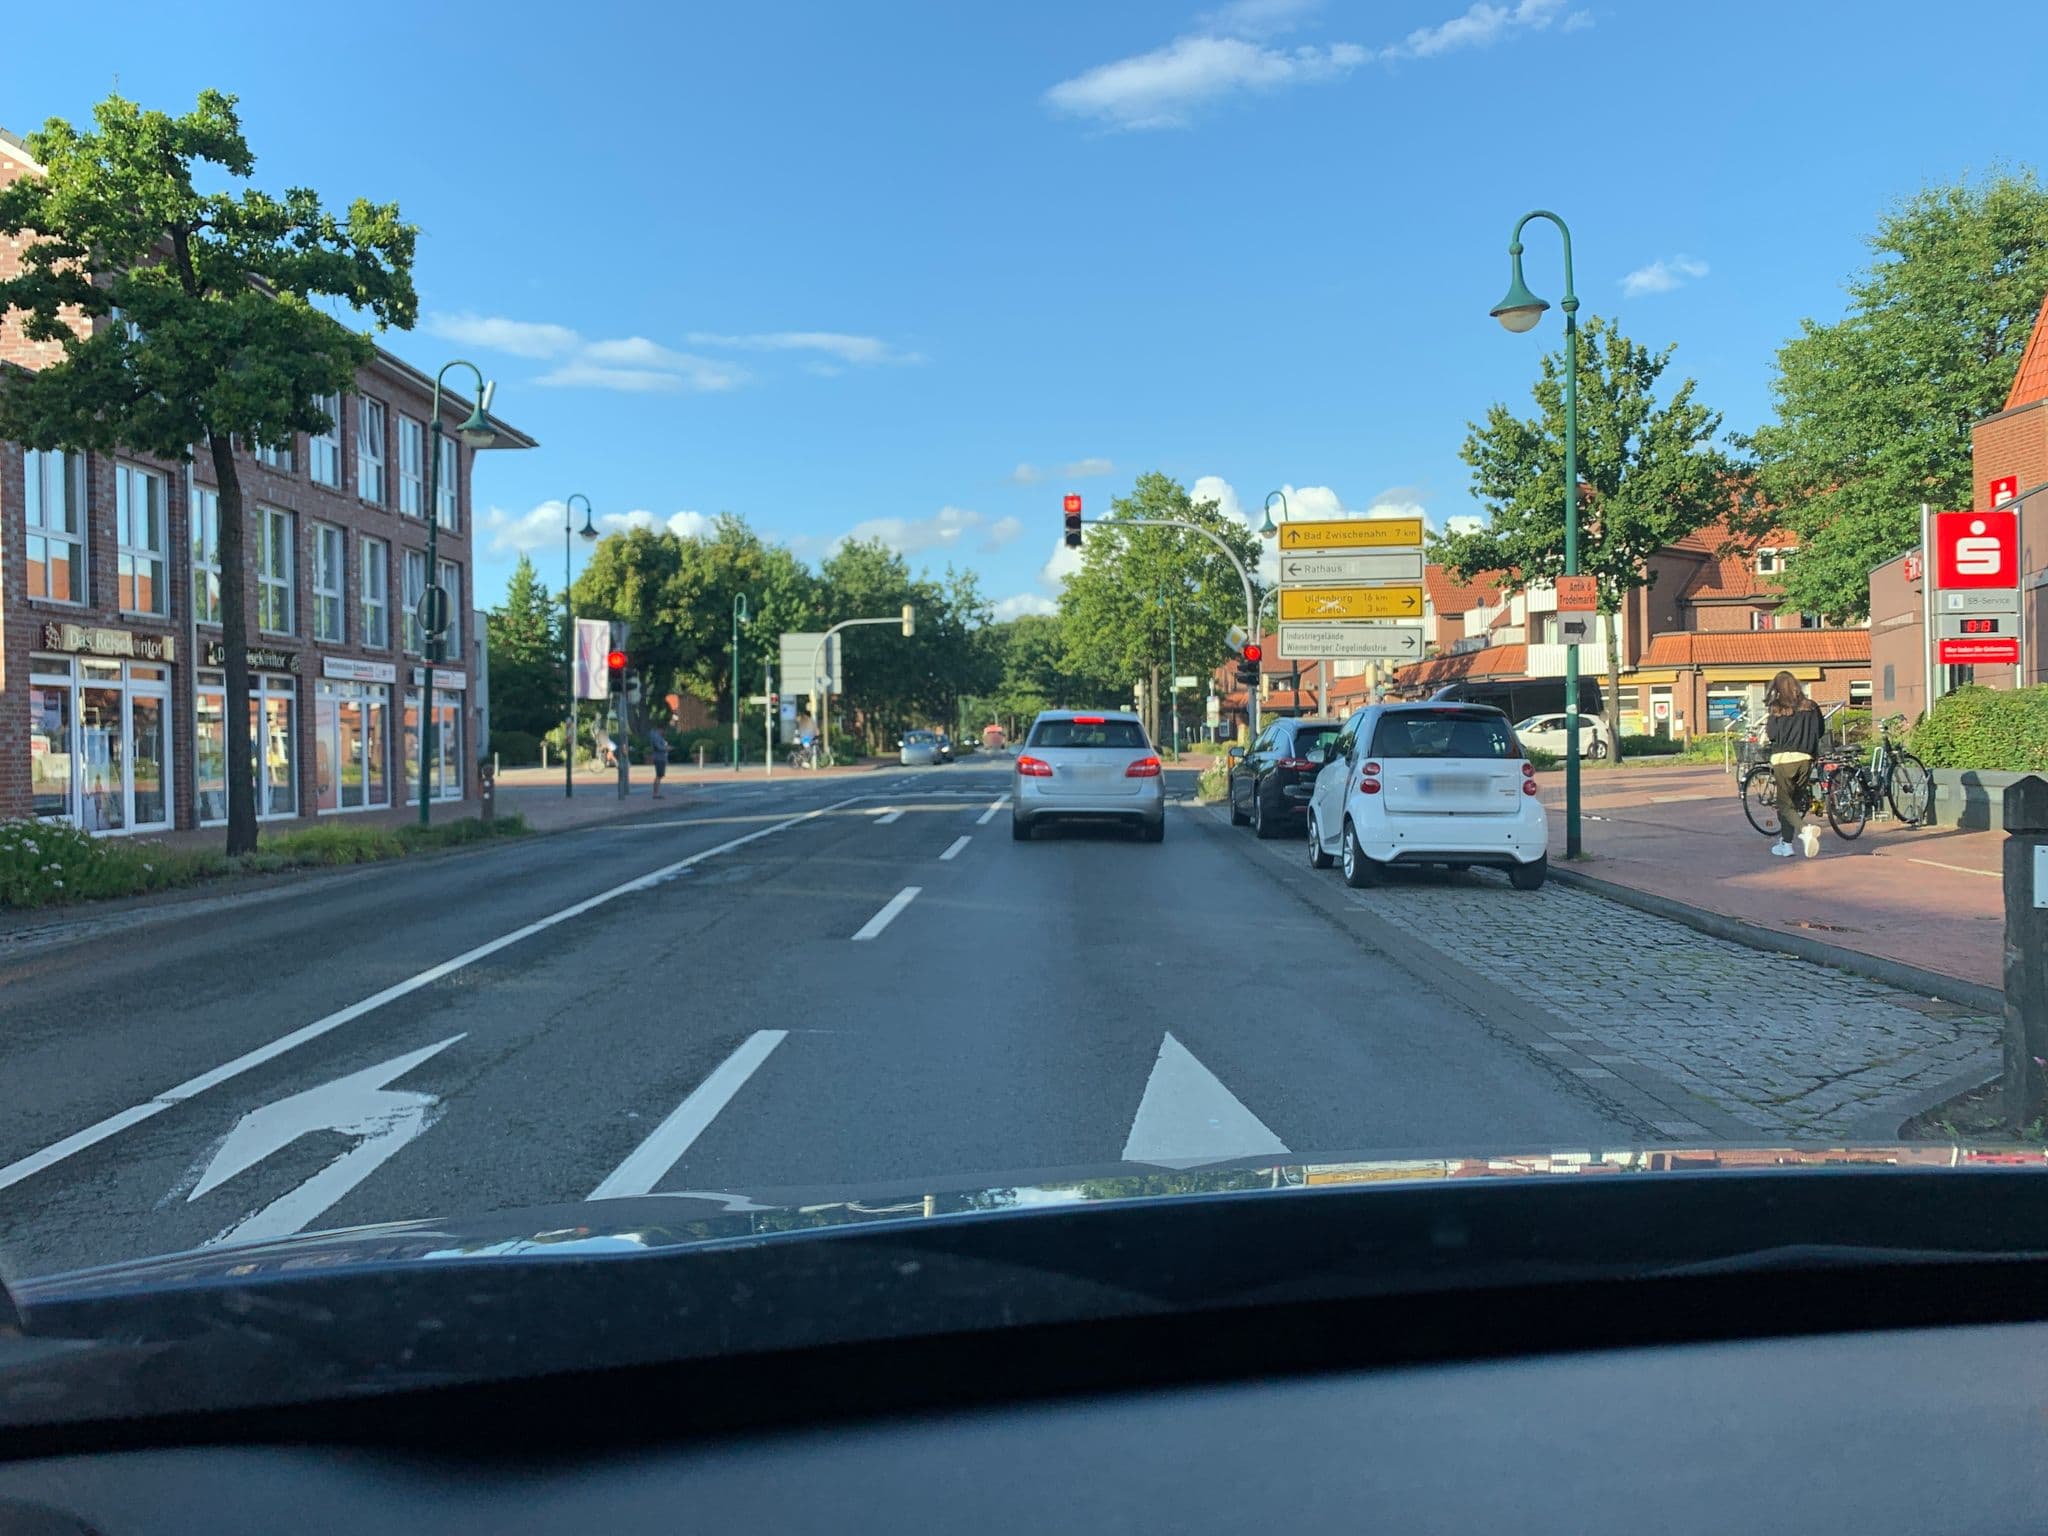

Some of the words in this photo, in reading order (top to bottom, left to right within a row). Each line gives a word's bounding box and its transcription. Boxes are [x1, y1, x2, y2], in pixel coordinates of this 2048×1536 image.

[1304, 532, 1322, 540] Bad
[1325, 529, 1387, 540] Zwischenahn
[1395, 528, 1401, 536] 7
[1304, 564, 1343, 574] Rathaus
[1363, 592, 1373, 601] 16
[1376, 592, 1388, 601] km
[1376, 604, 1388, 613] km
[71, 630, 92, 648] Das
